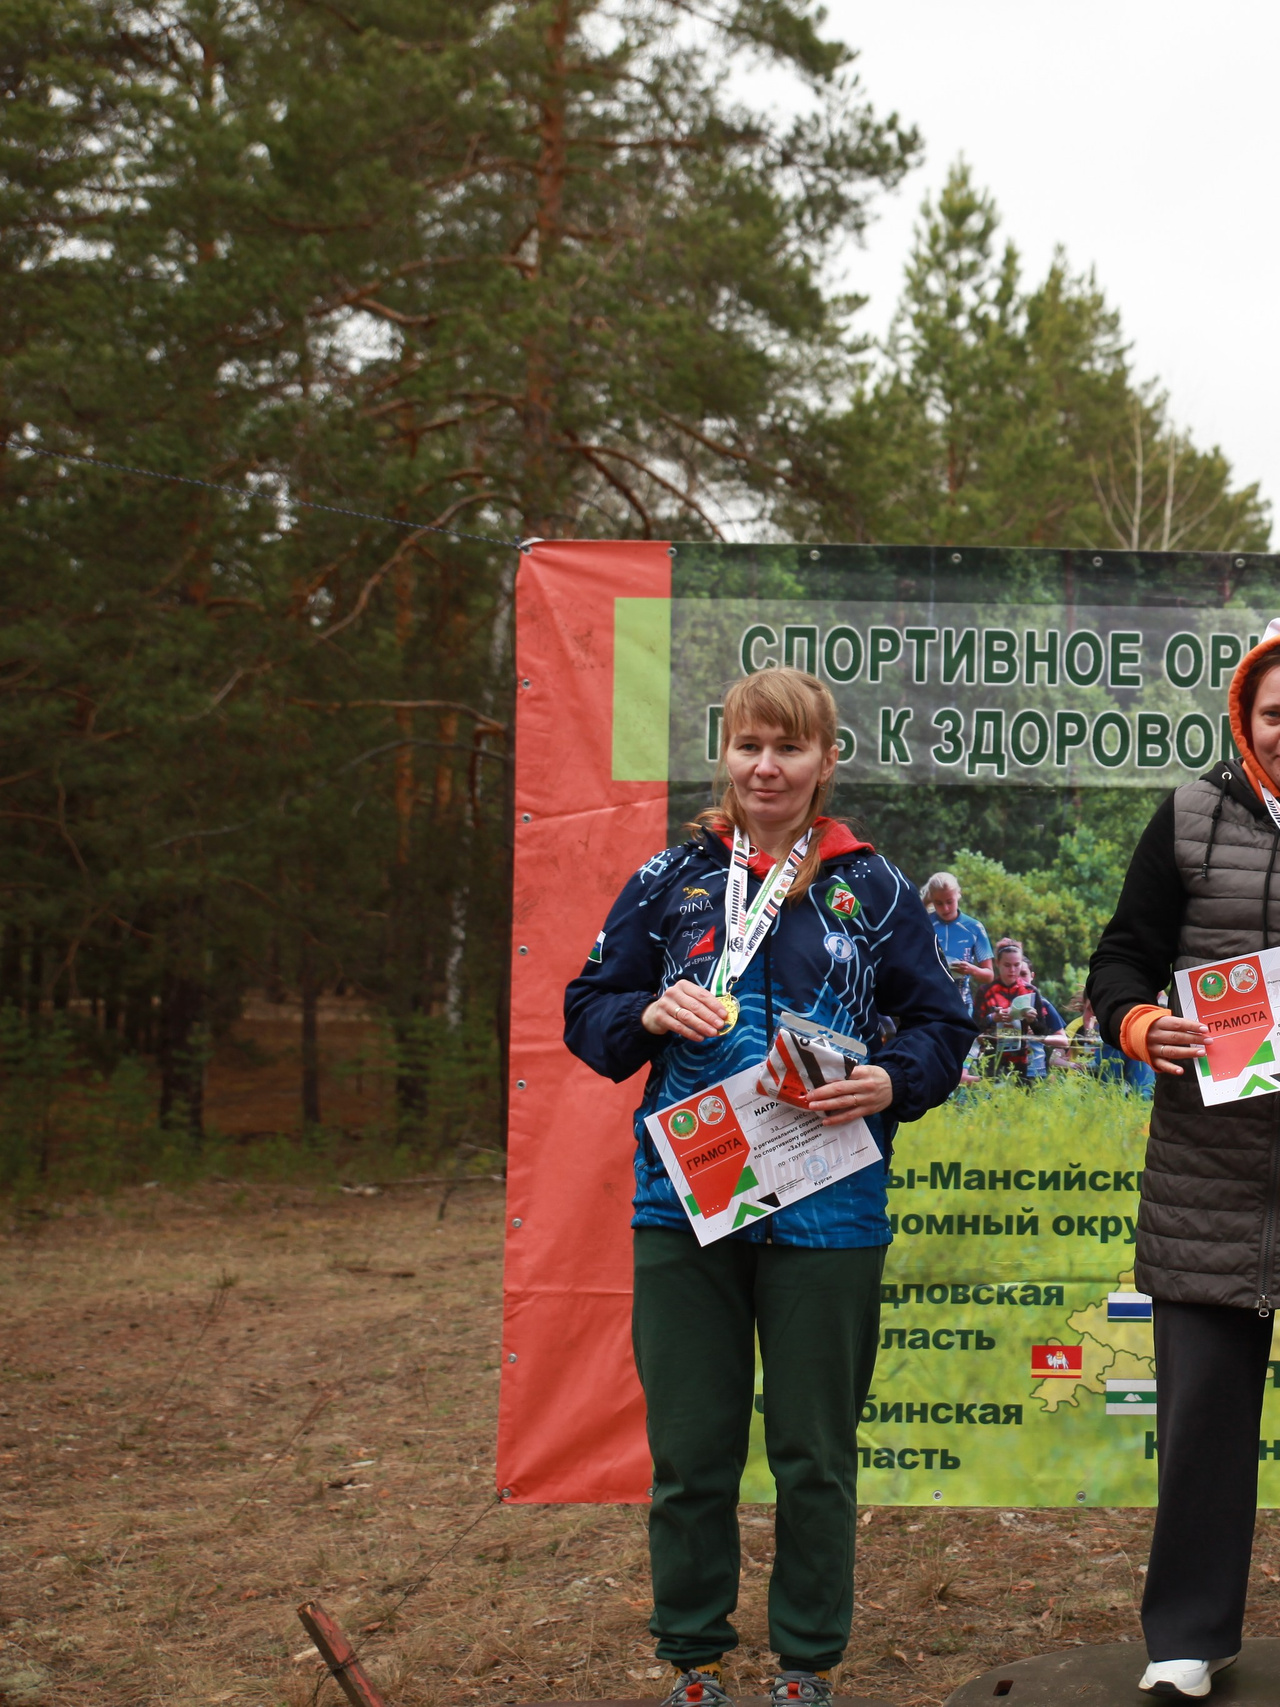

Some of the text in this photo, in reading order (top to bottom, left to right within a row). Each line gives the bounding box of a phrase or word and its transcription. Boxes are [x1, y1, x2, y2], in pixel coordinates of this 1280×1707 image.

[741, 625, 1142, 687] СПОРТИВНОЕ
[880, 708, 911, 763] К
[932, 707, 1236, 776] ЗДОРОВО
[1207, 1011, 1267, 1033] ГРАМОТА
[794, 1111, 811, 1121] мес
[799, 1116, 819, 1129] соревн
[800, 1122, 823, 1138] ориенти
[686, 1138, 742, 1171] ГРАМОТА
[814, 1175, 832, 1186] Курган
[886, 1162, 1143, 1191] ы-Мансийск
[1052, 1213, 1136, 1243] окру
[881, 1283, 1064, 1309] дловская
[880, 1327, 995, 1350] ласть
[860, 1394, 1022, 1425] бинская
